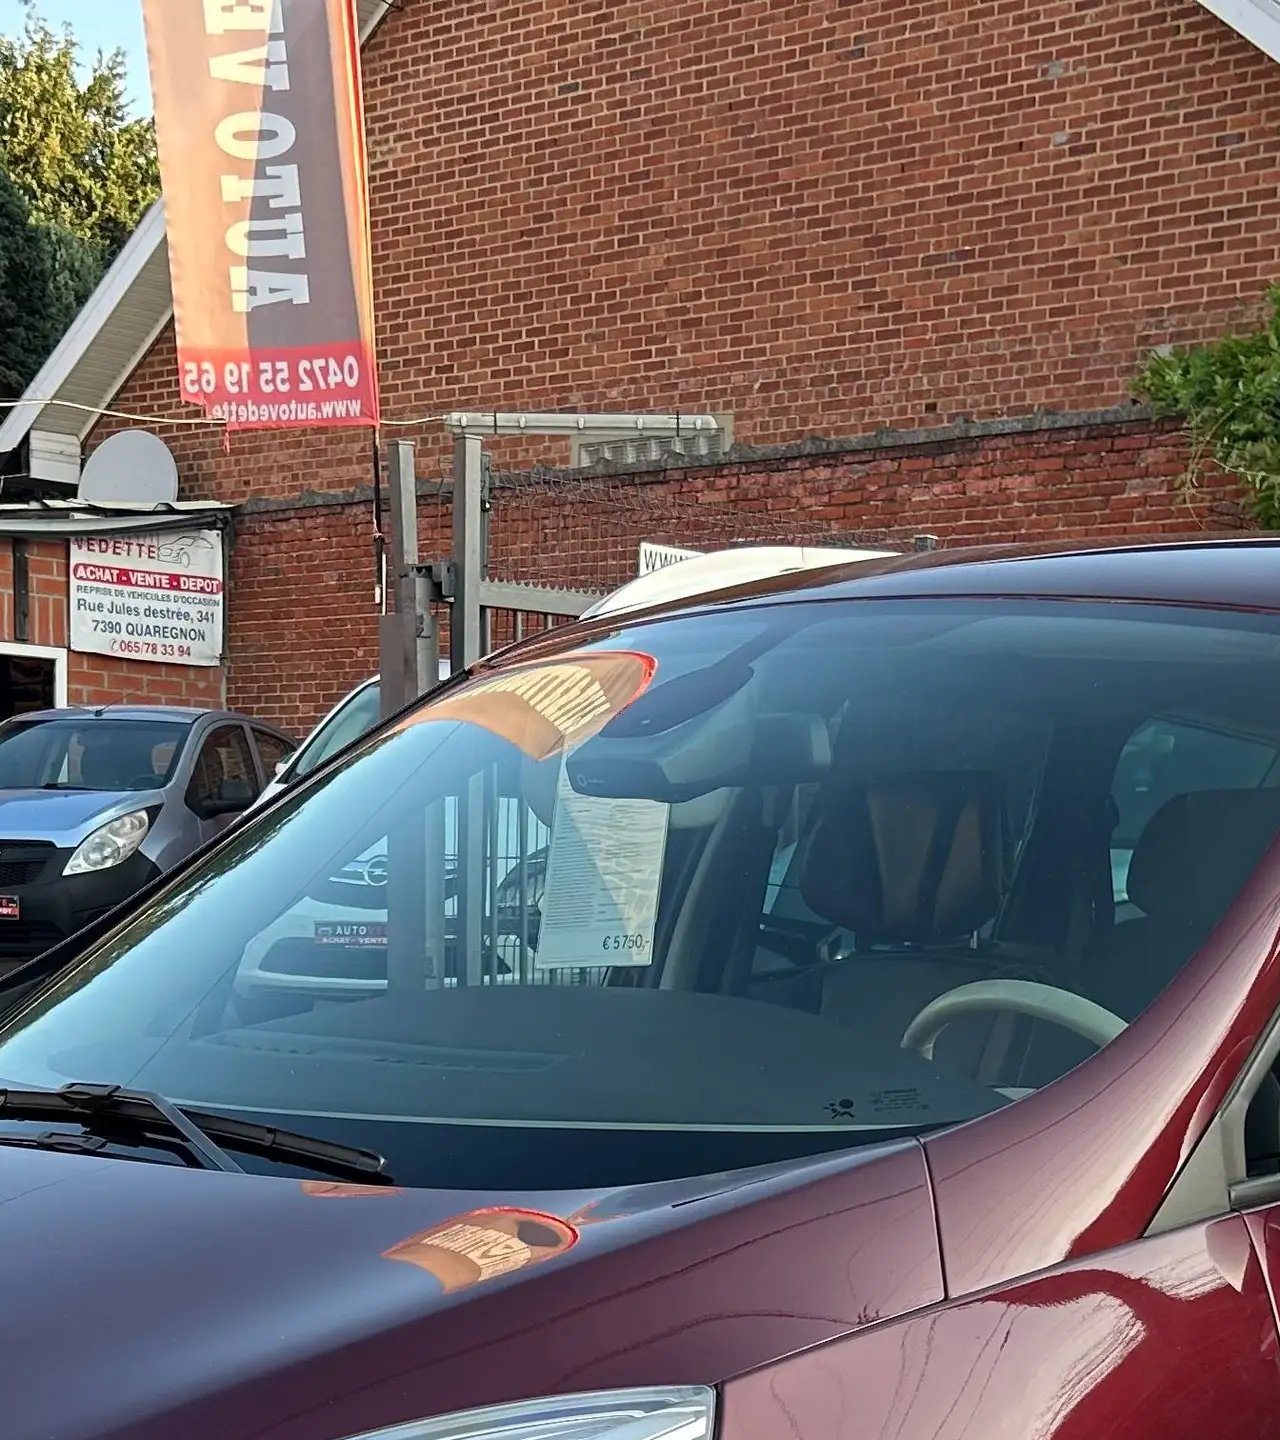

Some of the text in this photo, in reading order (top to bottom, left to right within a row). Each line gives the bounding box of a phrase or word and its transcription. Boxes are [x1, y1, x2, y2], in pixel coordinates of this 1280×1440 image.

[72, 536, 157, 560] VEDETTE
[76, 565, 119, 582] ACHAT
[128, 570, 170, 589] VENTE
[180, 576, 220, 593] DEPOT
[76, 585, 114, 597] REPRISE
[114, 587, 126, 598] DE
[127, 589, 171, 603] VEHICULES
[77, 598, 215, 624] Rue Jules destrée, 341
[92, 619, 206, 641] 7390 QUAREGNON
[120, 640, 191, 657] 065/78 33 94
